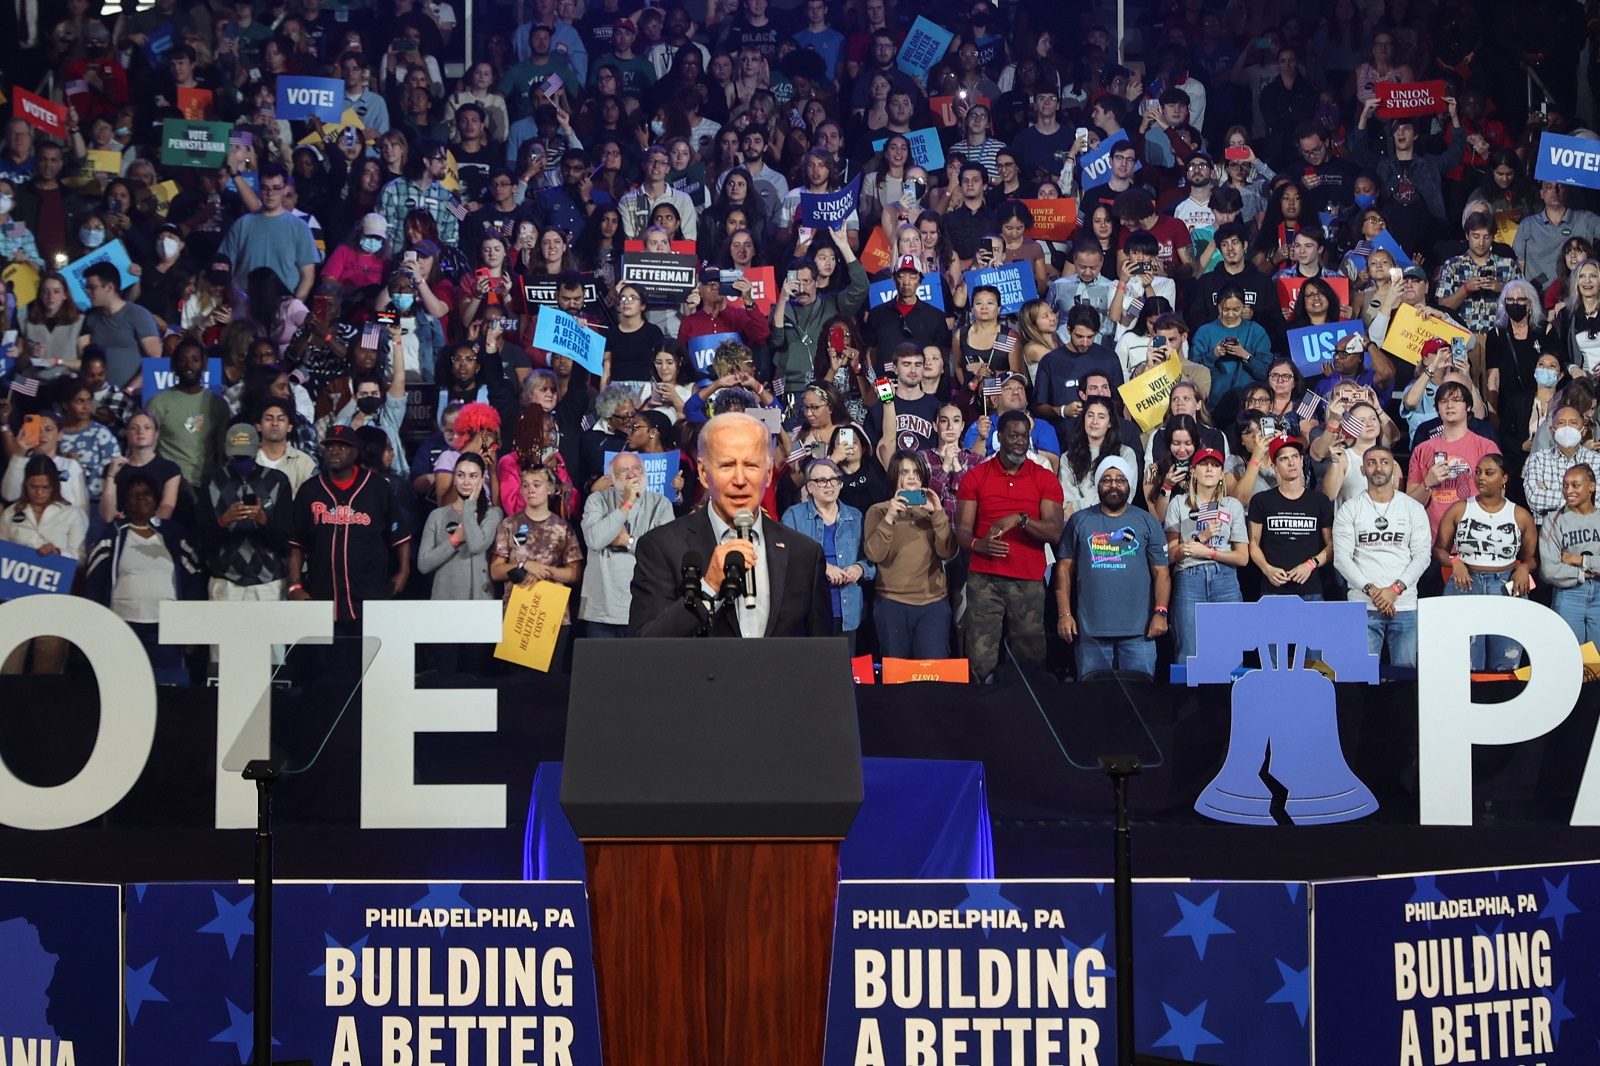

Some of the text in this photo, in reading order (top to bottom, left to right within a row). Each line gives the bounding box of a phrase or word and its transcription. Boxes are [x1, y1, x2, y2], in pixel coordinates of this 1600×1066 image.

[902, 29, 924, 62] BUILDING
[915, 34, 932, 60] BETTER
[920, 40, 941, 71] AMERICA
[287, 87, 335, 108] VOTE!
[1386, 97, 1435, 108] STRONG
[1390, 89, 1429, 100] UNION
[21, 98, 59, 127] VOTE!
[168, 138, 225, 152] PENNSYLVANIA
[188, 129, 208, 141] VOTE
[1084, 152, 1112, 180] VOT
[1550, 147, 1600, 172] VOTE!
[817, 190, 853, 211] UNION
[629, 268, 690, 283] FETTERMAN
[980, 268, 1021, 285] BUILDING
[997, 279, 1023, 294] ETTER
[1001, 291, 1025, 306] ERICA
[555, 315, 591, 344] BUILDING
[562, 328, 590, 352] BETTER
[552, 335, 589, 361] AMERICA
[1148, 375, 1170, 392] VOTE
[896, 414, 932, 439] ENN
[644, 459, 668, 472] DING
[311, 501, 372, 526] Phillies
[1270, 519, 1314, 529] FETTERMAN
[1358, 532, 1405, 543] EDGE
[1, 557, 62, 592] VOTE!
[514, 604, 529, 635] LOWER
[519, 592, 542, 651] HEALTH CARE
[534, 611, 547, 638] COSTS
[365, 908, 576, 932] PHILADELPHIA, PA
[1405, 894, 1538, 922] PHILADELPHIA, PA
[852, 909, 1066, 933] PHILADELPHIA, PA
[325, 947, 574, 1007] BUILDING
[1394, 929, 1553, 1001] BUILDING
[854, 948, 1107, 1009] BUILDING
[331, 1015, 575, 1066] A BETTER
[854, 1018, 1102, 1066] A BETTER
[1400, 996, 1554, 1066] A BETTER
